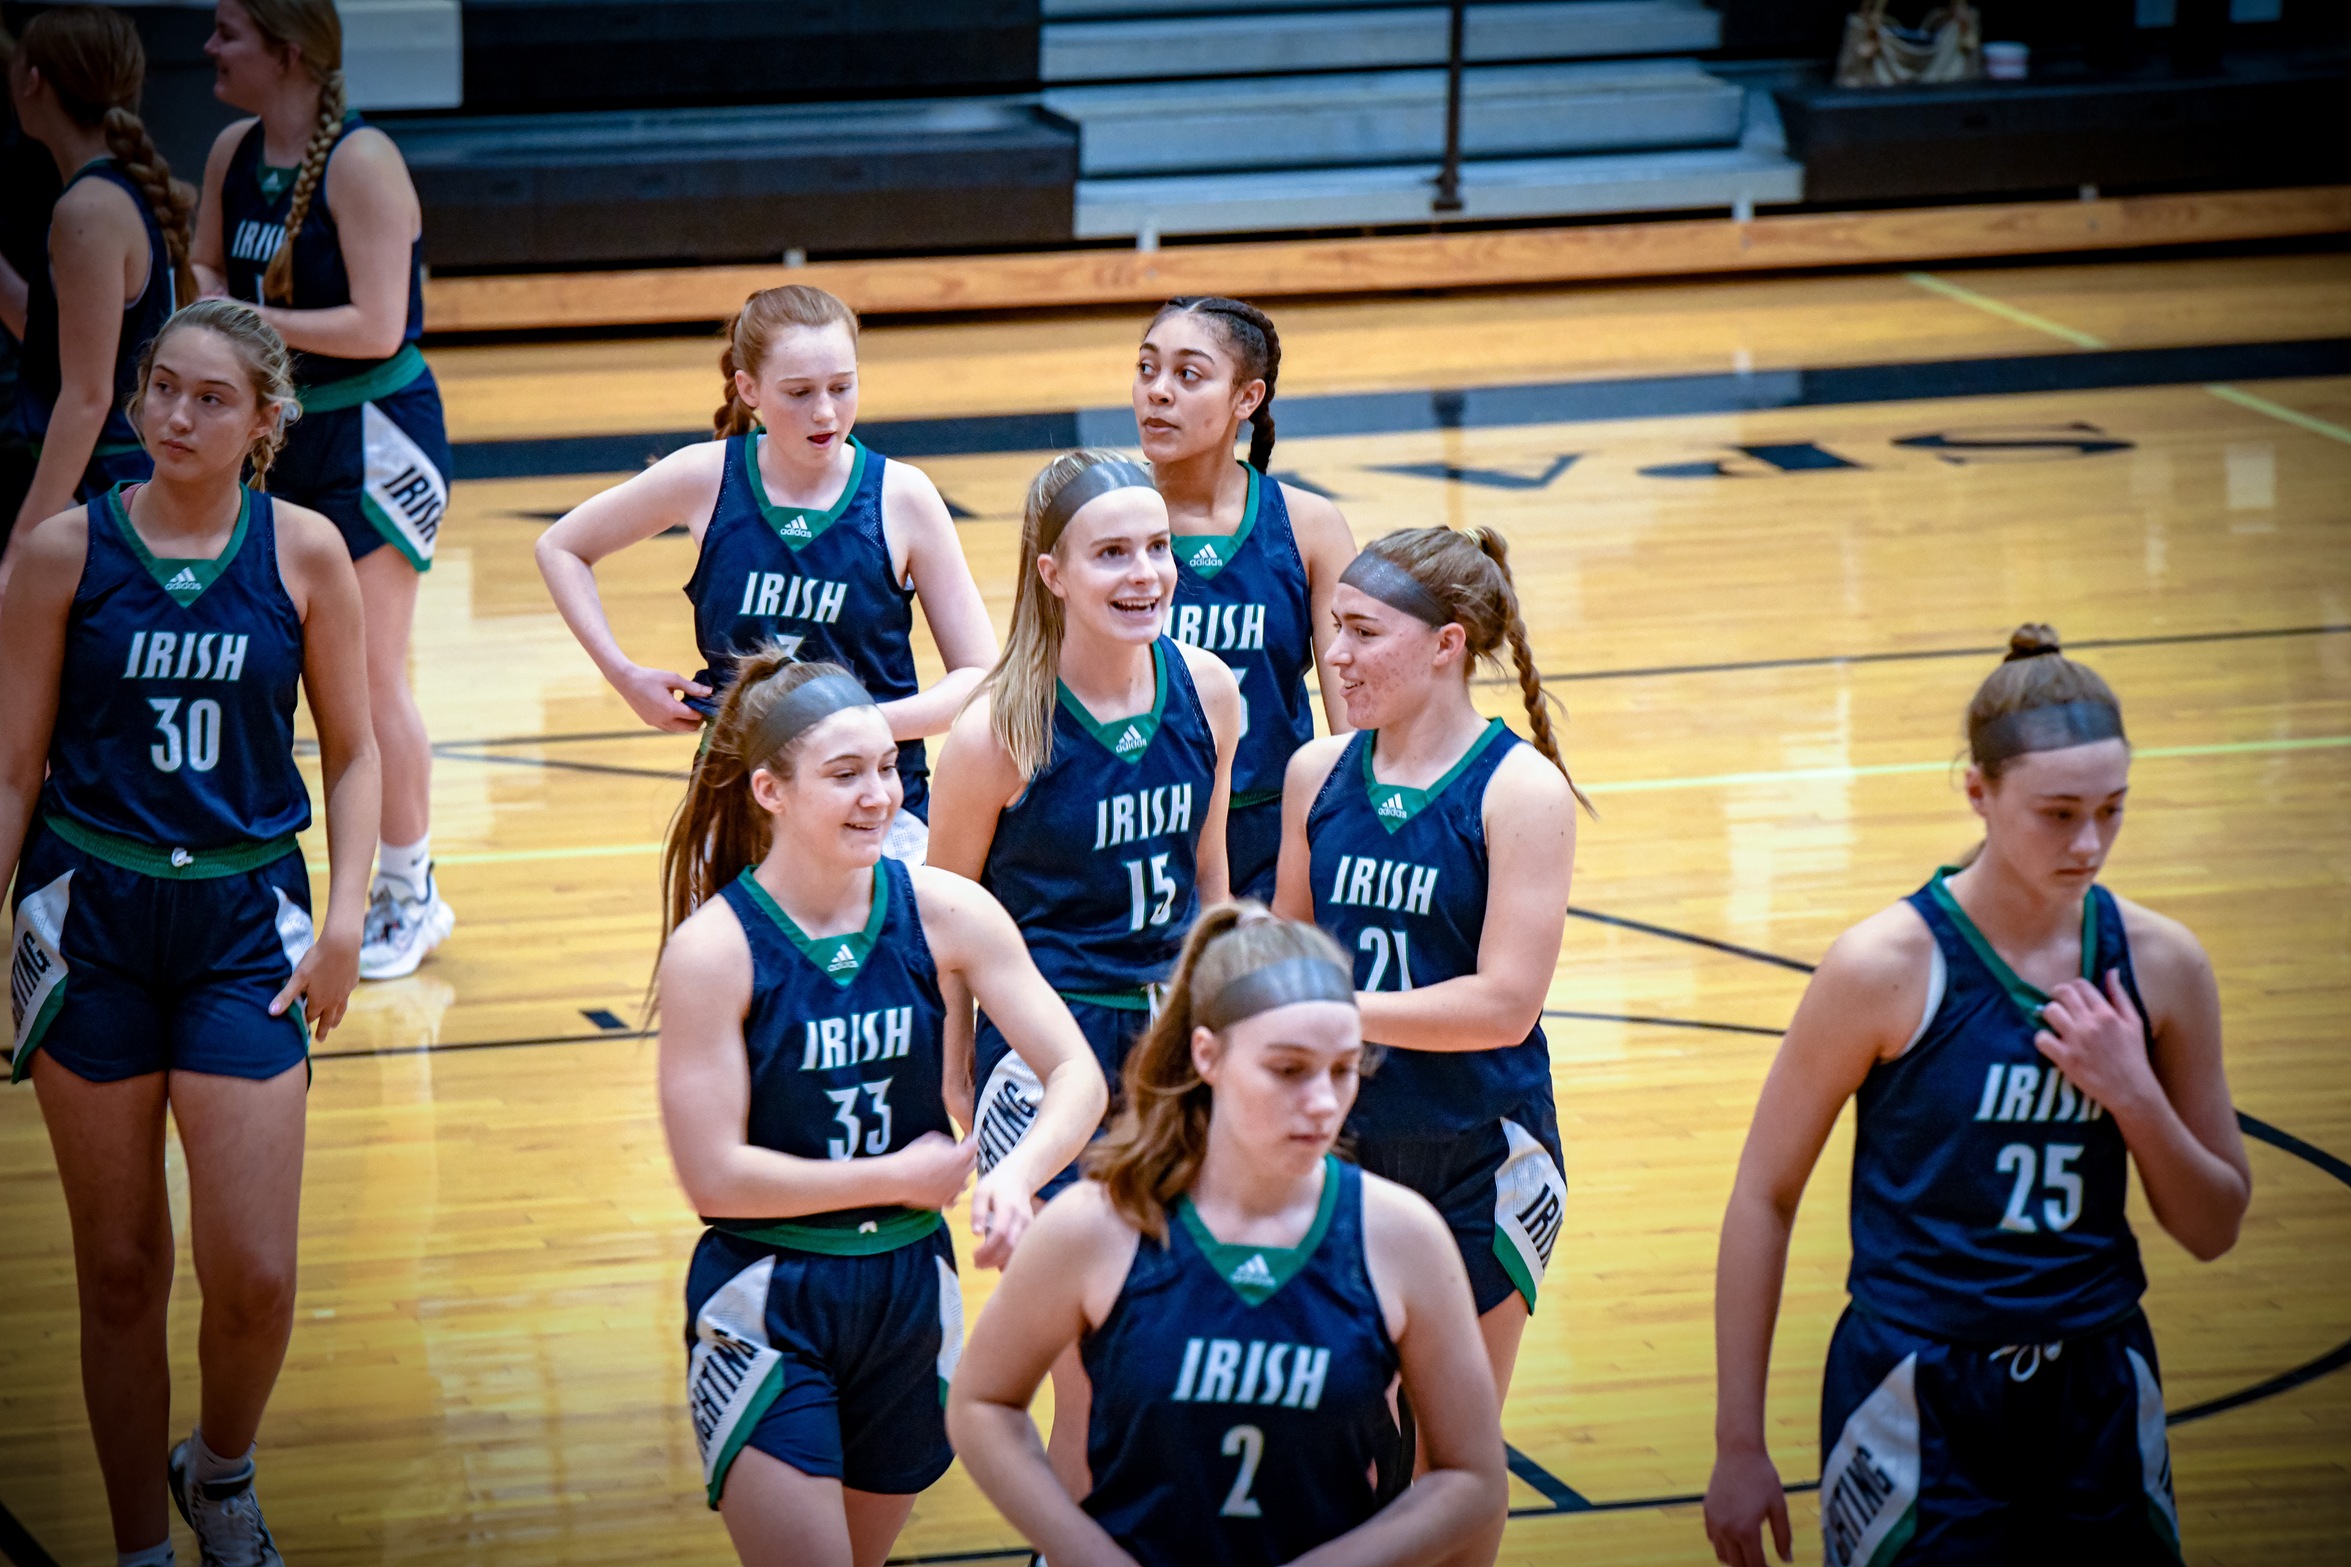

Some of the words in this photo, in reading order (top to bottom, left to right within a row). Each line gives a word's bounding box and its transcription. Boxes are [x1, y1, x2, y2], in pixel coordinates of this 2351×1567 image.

[780, 527, 812, 538] adidas
[1189, 556, 1223, 568] adidas
[164, 581, 202, 591] adidas
[738, 571, 848, 624] IRISH
[121, 630, 249, 681] IRISH
[146, 697, 221, 773] 30
[1115, 737, 1148, 753] adidas
[1092, 782, 1192, 851] IRISH
[1378, 807, 1407, 819] adidas
[1121, 852, 1177, 932] 15
[1328, 855, 1439, 916] IRISH
[1358, 926, 1413, 992] 21
[798, 1005, 913, 1071] IRISH
[823, 1076, 894, 1161] 33
[1996, 1143, 2084, 1233] 25
[1172, 1338, 1331, 1411] IRISH
[1219, 1423, 1264, 1518] 2
